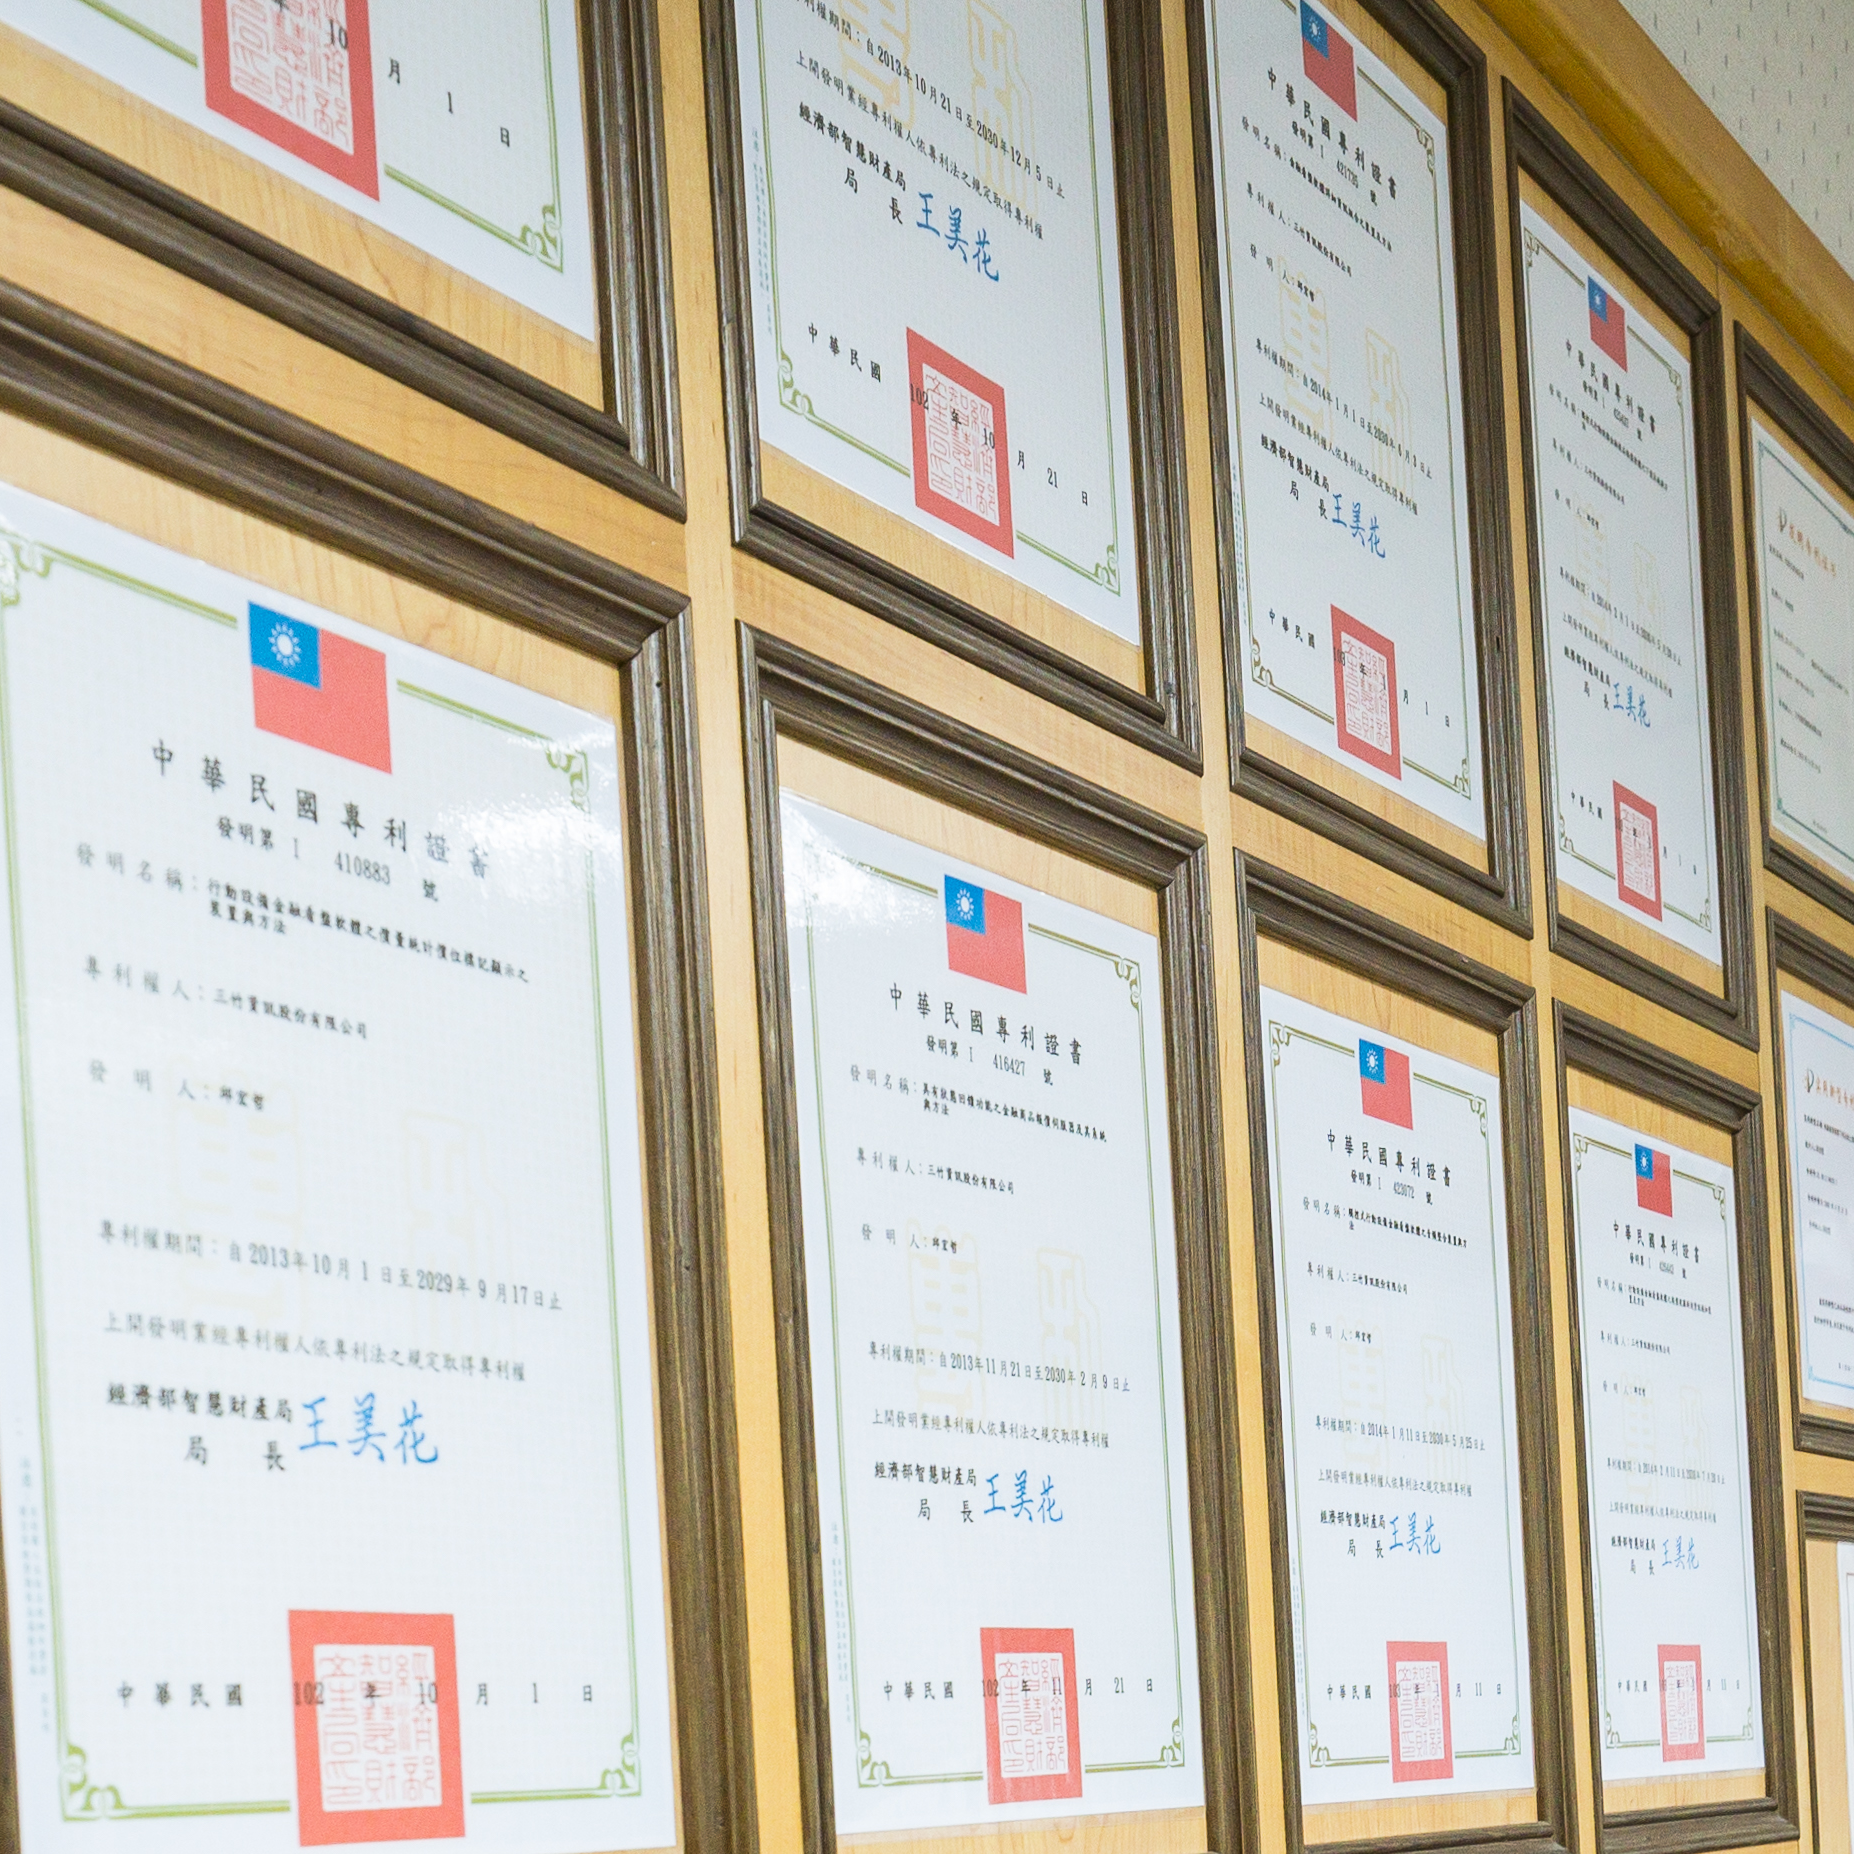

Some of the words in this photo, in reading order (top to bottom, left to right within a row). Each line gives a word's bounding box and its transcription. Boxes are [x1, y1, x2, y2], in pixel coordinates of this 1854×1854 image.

[388, 58, 402, 86] 月
[498, 125, 511, 149] 日
[1266, 66, 1397, 200] 中華民國專利證書
[798, 100, 906, 192] 經濟部智慧財產局
[915, 190, 1000, 283] 王美花
[807, 321, 881, 383] 中華民國
[908, 377, 929, 413] 102
[1016, 449, 1025, 470] 月
[1046, 466, 1058, 489] 21
[1080, 489, 1088, 507] 日
[1260, 432, 1329, 493] 經濟部智慧財產局
[1330, 492, 1386, 559] 王美花
[151, 738, 488, 879] 中華民國專利證書
[215, 815, 274, 851] 發明第
[333, 850, 391, 886] 410883
[421, 877, 439, 902] 號
[213, 988, 367, 1040] 三竹資訊股份有限公司
[889, 981, 1082, 1066] 中華民國專利證書
[926, 1034, 959, 1059] 發明第
[992, 1052, 1025, 1077] 416427
[1042, 1067, 1053, 1086] 號
[927, 1163, 1014, 1195] 三竹資訊股份有限公司
[1326, 1127, 1451, 1188] 中華民國專利證書
[1350, 1168, 1372, 1187] 發明第
[1425, 1190, 1433, 1206] 號
[106, 1382, 292, 1423] 經濟部智慧財產局
[297, 1391, 439, 1465] 王美花
[873, 1460, 977, 1487] 經濟部智慧財產局
[982, 1468, 1063, 1523] 王美花
[1319, 1509, 1386, 1529] 經濟部智慧財產局
[1388, 1510, 1441, 1555] 王美花
[116, 1680, 243, 1708] 中華民國
[882, 1680, 954, 1701] 中華民國
[980, 1677, 1002, 1704] 102
[1083, 1677, 1092, 1696] 月
[1113, 1676, 1125, 1694] 21
[1145, 1677, 1153, 1692] 日
